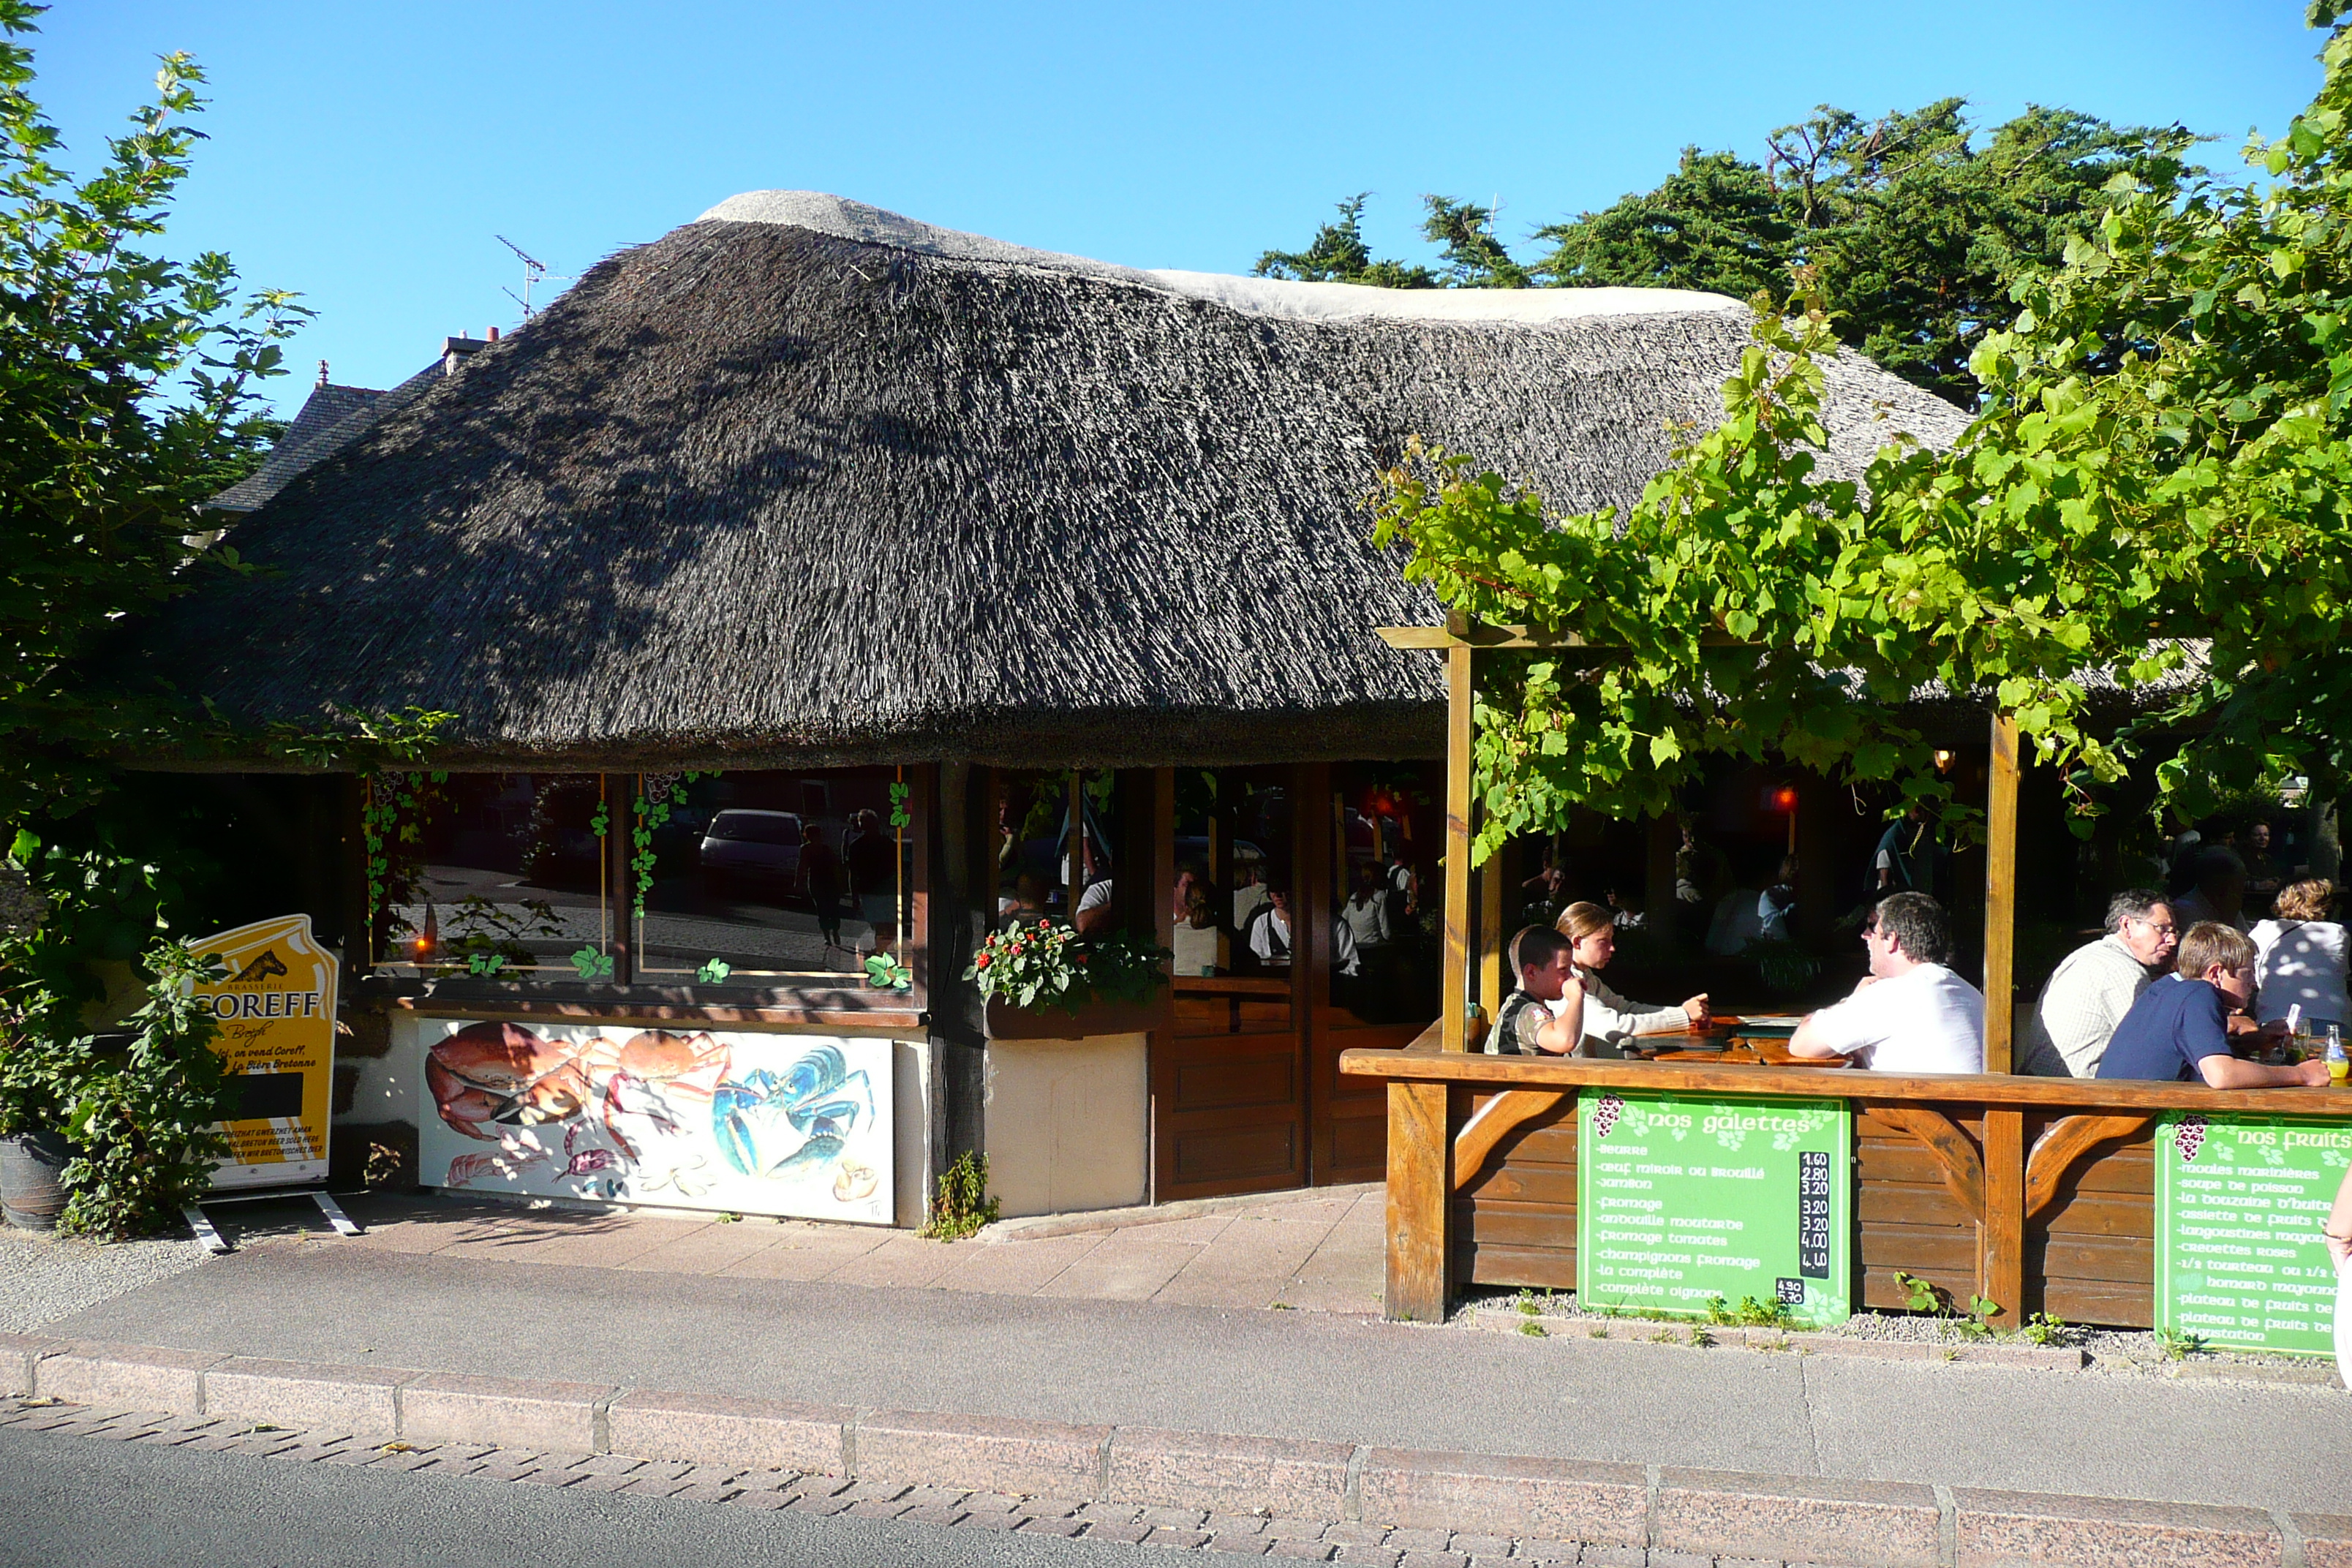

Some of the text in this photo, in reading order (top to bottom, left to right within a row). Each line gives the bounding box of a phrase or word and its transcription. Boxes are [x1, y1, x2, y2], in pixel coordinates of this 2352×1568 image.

[234, 1049, 246, 1058] on
[248, 1047, 273, 1057] vend
[233, 1060, 316, 1071] La Bière Bretonne
[1648, 1113, 1810, 1134] nos galettes
[2238, 1131, 2352, 1151] nos fruits
[1803, 1153, 1827, 1165] 1.60
[1689, 1166, 1706, 1177] ou
[1801, 1167, 1828, 1181] 2.80
[2238, 1166, 2320, 1180] marinières
[1802, 1181, 1828, 1195] 3.20
[2228, 1180, 2245, 1191] de
[2251, 1183, 2304, 1194] poisson
[1803, 1200, 1828, 1214] 3.20
[2201, 1194, 2271, 1207] douzaine
[2277, 1197, 2332, 1211] d'huitr
[1670, 1218, 1743, 1230] moutarde
[1803, 1216, 1828, 1231] 3.20
[2244, 1213, 2261, 1223] de
[2268, 1214, 2312, 1226] fruits
[1668, 1233, 1727, 1245] tomates
[1801, 1232, 1827, 1248] 4.00
[2276, 1231, 2326, 1245] mayon
[2256, 1247, 2296, 1258] roses
[1697, 1254, 1760, 1270] fromage
[2207, 1259, 2274, 1273] tourteau
[2282, 1266, 2300, 1276] ou
[2306, 1266, 2327, 1278] 1/2
[1618, 1267, 1683, 1280] complète
[2207, 1275, 2339, 1296] homard mayonna
[1670, 1286, 1723, 1300] oignons
[2242, 1297, 2259, 1308] de
[2265, 1299, 2309, 1313] fruits
[2315, 1303, 2332, 1313] de
[2241, 1316, 2258, 1327] de
[2264, 1318, 2308, 1331] fruits
[2313, 1322, 2332, 1333] de
[2180, 1326, 2264, 1341] dégustation
